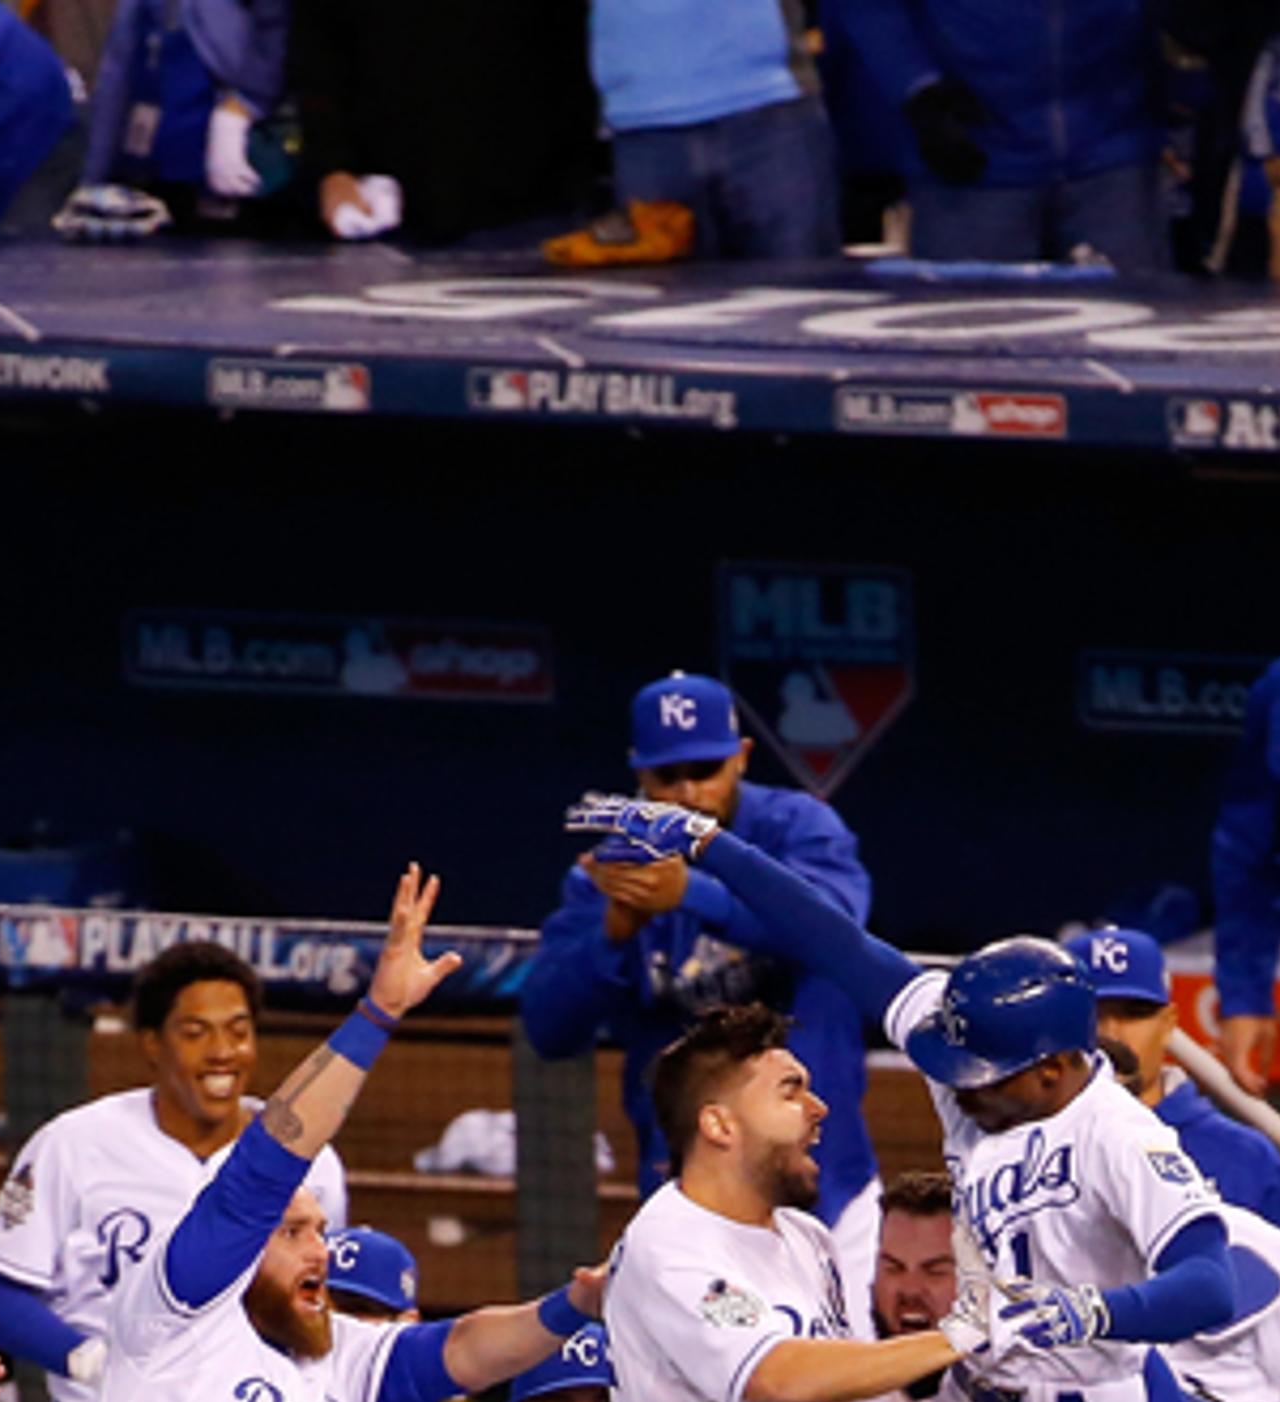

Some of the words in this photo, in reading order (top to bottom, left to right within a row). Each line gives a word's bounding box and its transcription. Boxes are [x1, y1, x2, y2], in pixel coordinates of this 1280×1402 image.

[219, 368, 322, 400] MLB.com
[842, 394, 951, 425] MLB.com
[1223, 401, 1278, 449] At
[730, 577, 902, 638] MLB
[138, 623, 336, 677] MLB.com
[660, 693, 697, 731] KC
[1090, 663, 1248, 720] MLB.co
[1091, 937, 1128, 972] KC
